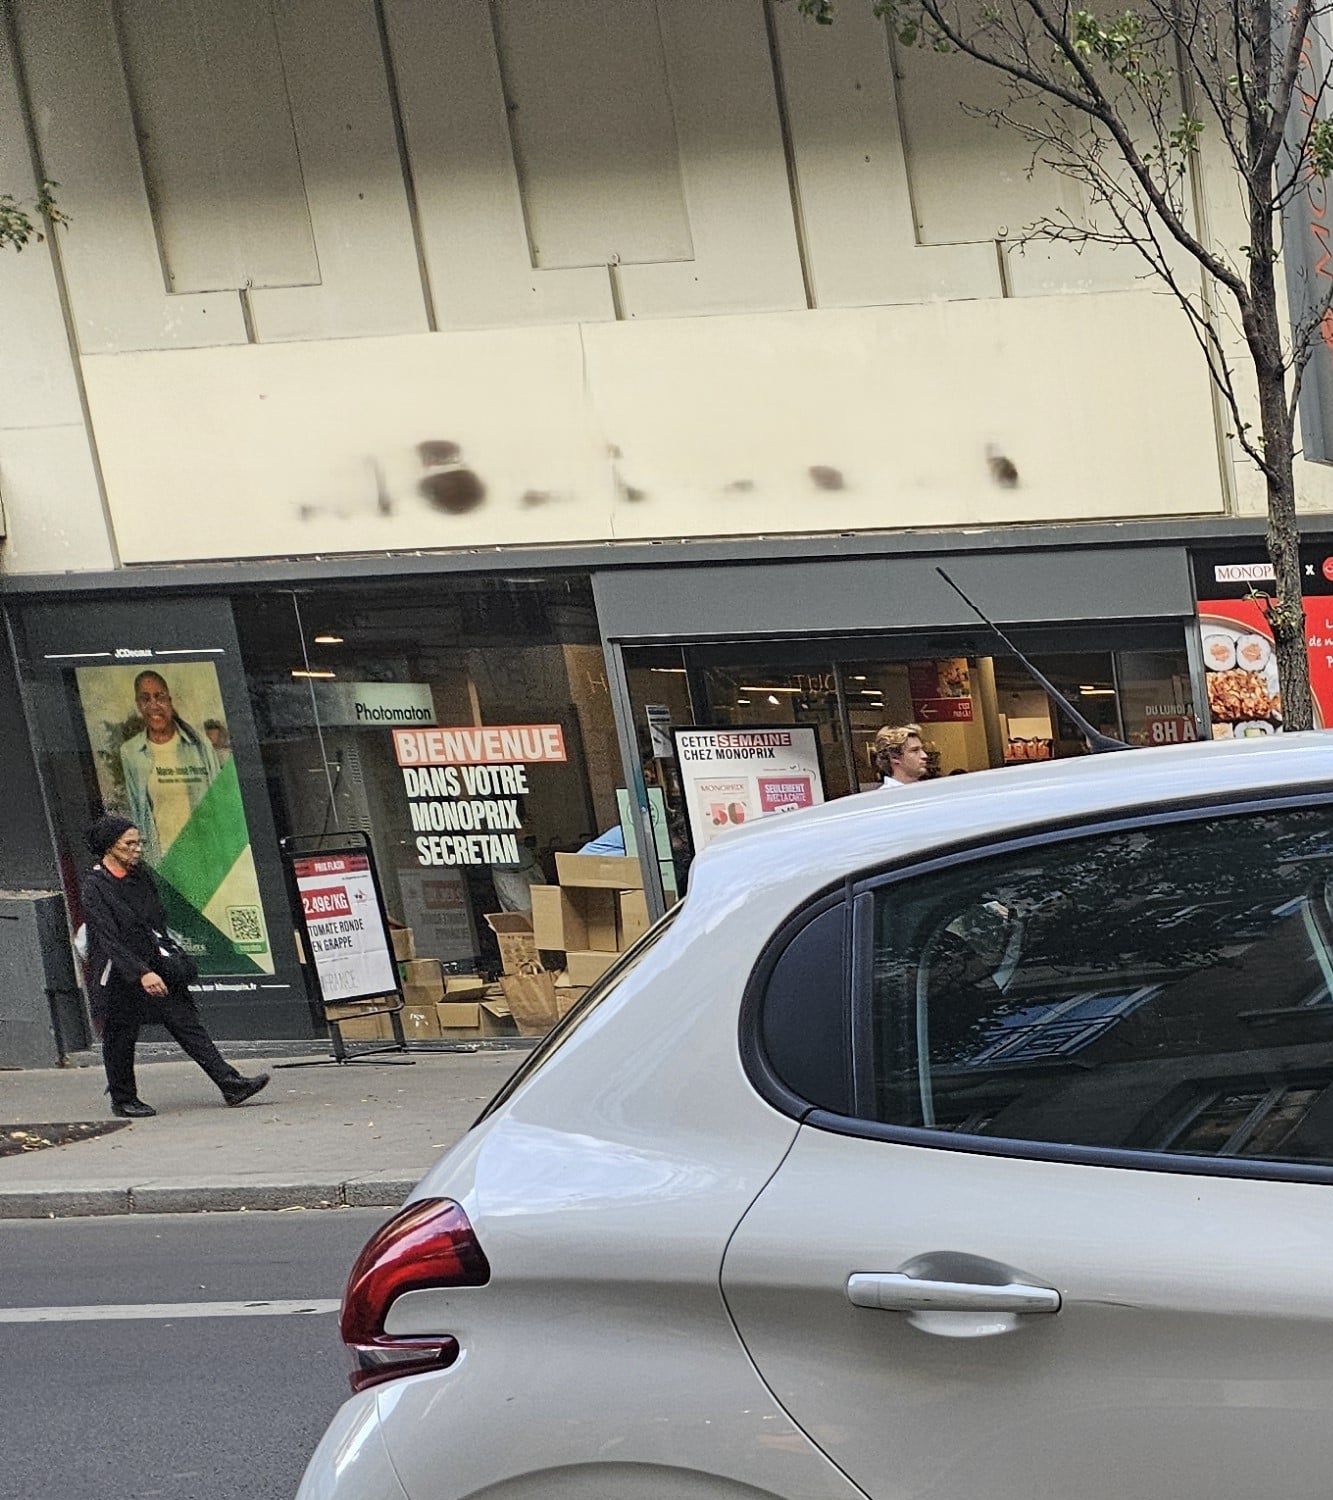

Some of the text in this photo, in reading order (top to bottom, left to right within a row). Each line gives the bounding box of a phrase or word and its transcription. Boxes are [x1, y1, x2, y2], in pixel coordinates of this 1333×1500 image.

[1218, 566, 1276, 580] MONOP
[1309, 635, 1322, 647] de
[355, 702, 432, 721] Photomaton
[1145, 705, 1158, 716] DU
[1160, 703, 1185, 715] LUNDI
[1152, 715, 1196, 743] 8H À
[397, 729, 562, 763] BIENVENUE
[681, 732, 791, 748] CETTE SEMAINE
[684, 748, 776, 760] CHEZ MONOPRIX
[403, 764, 530, 798] DANS VOTRE
[764, 783, 805, 794] SEULEMENT
[408, 799, 522, 832] MONOPRIX
[415, 833, 521, 866] SECRETAN
[302, 892, 348, 914] 2.49€/KG
[308, 918, 364, 937] TOMATE RONDE
[312, 936, 353, 952] EN GRAPPE
